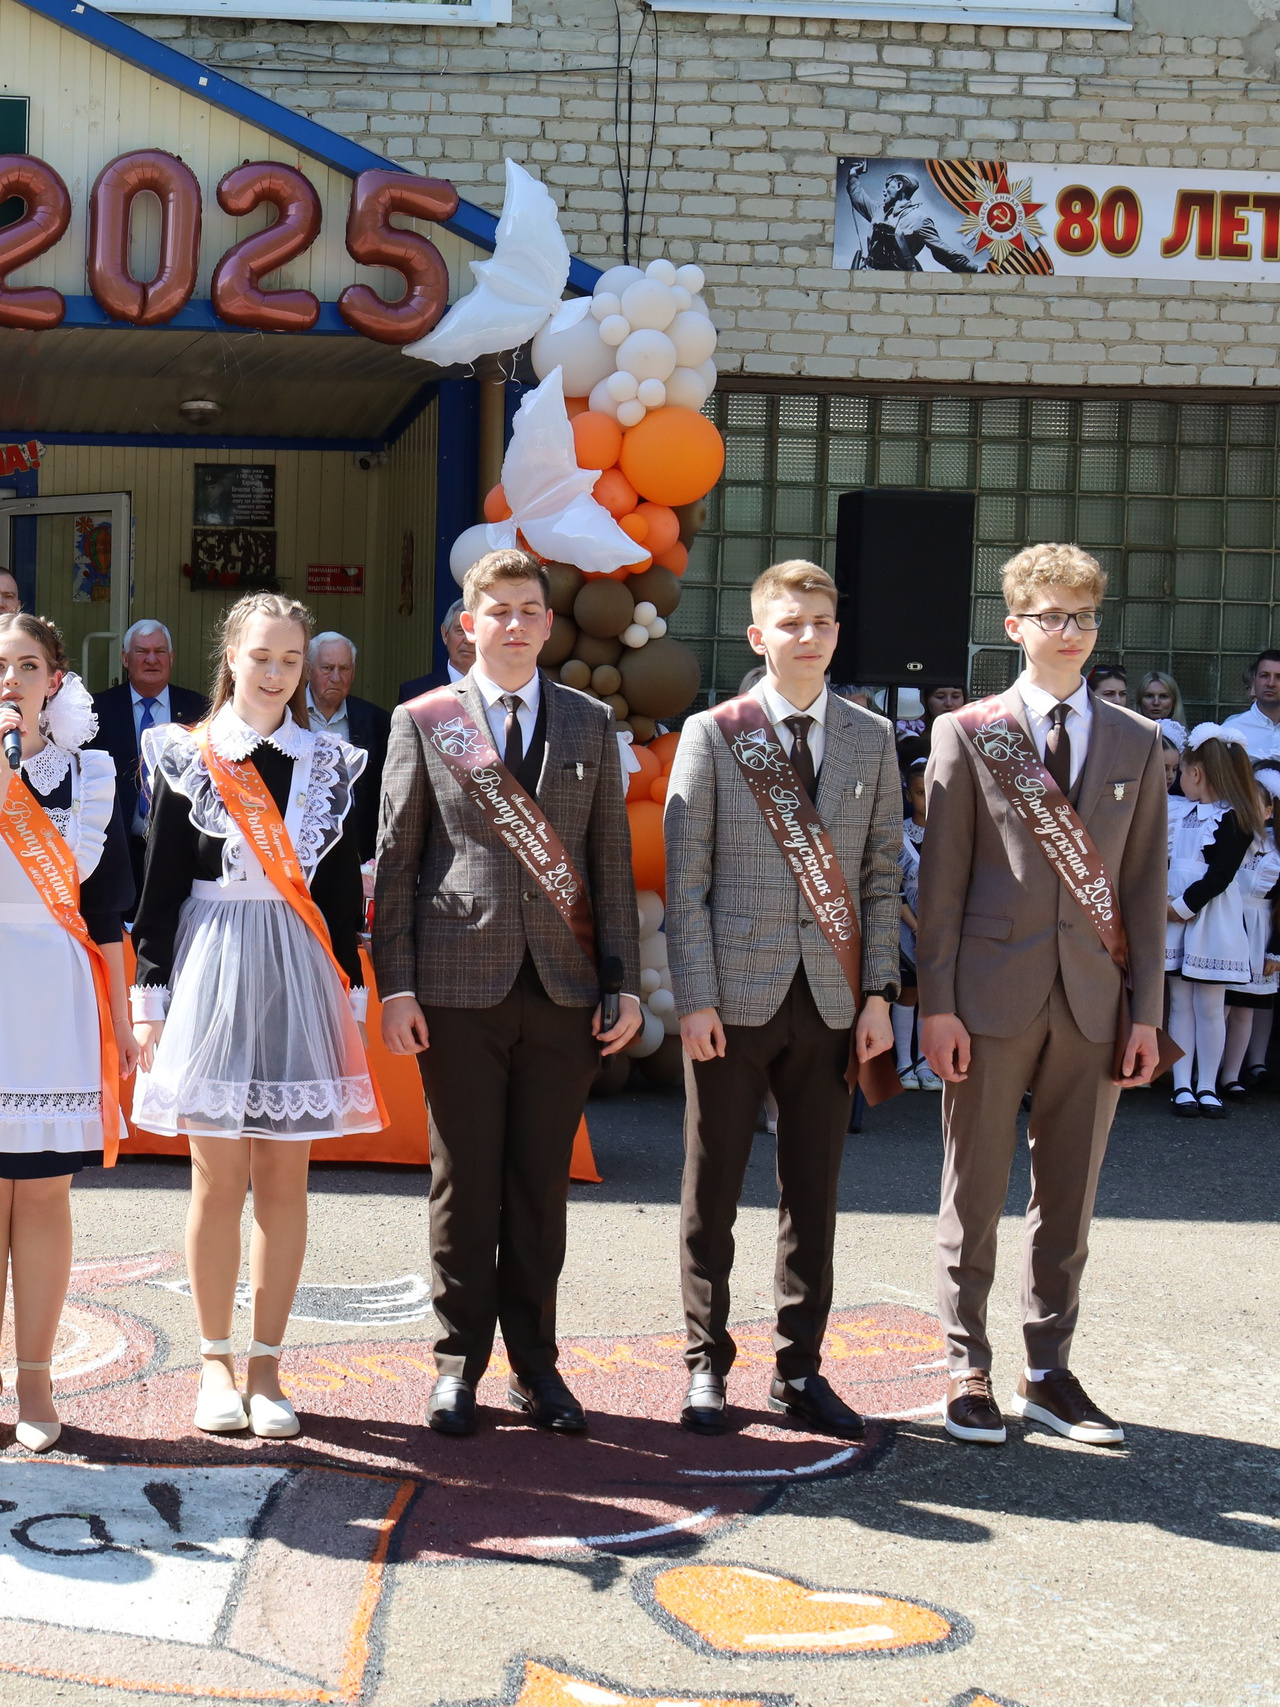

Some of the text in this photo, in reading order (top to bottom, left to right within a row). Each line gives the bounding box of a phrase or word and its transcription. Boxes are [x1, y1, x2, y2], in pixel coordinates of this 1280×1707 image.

[980, 195, 1024, 236] ОТЕЧЕСТВЕННАЯ ВОЙНА
[1053, 184, 1280, 262] 80 ЛЕТ
[1, 798, 74, 908] Выпускница
[470, 764, 581, 906] Выпускник 2025
[769, 785, 854, 940] Выпускник 2025
[1014, 774, 1089, 879] Выпускник
